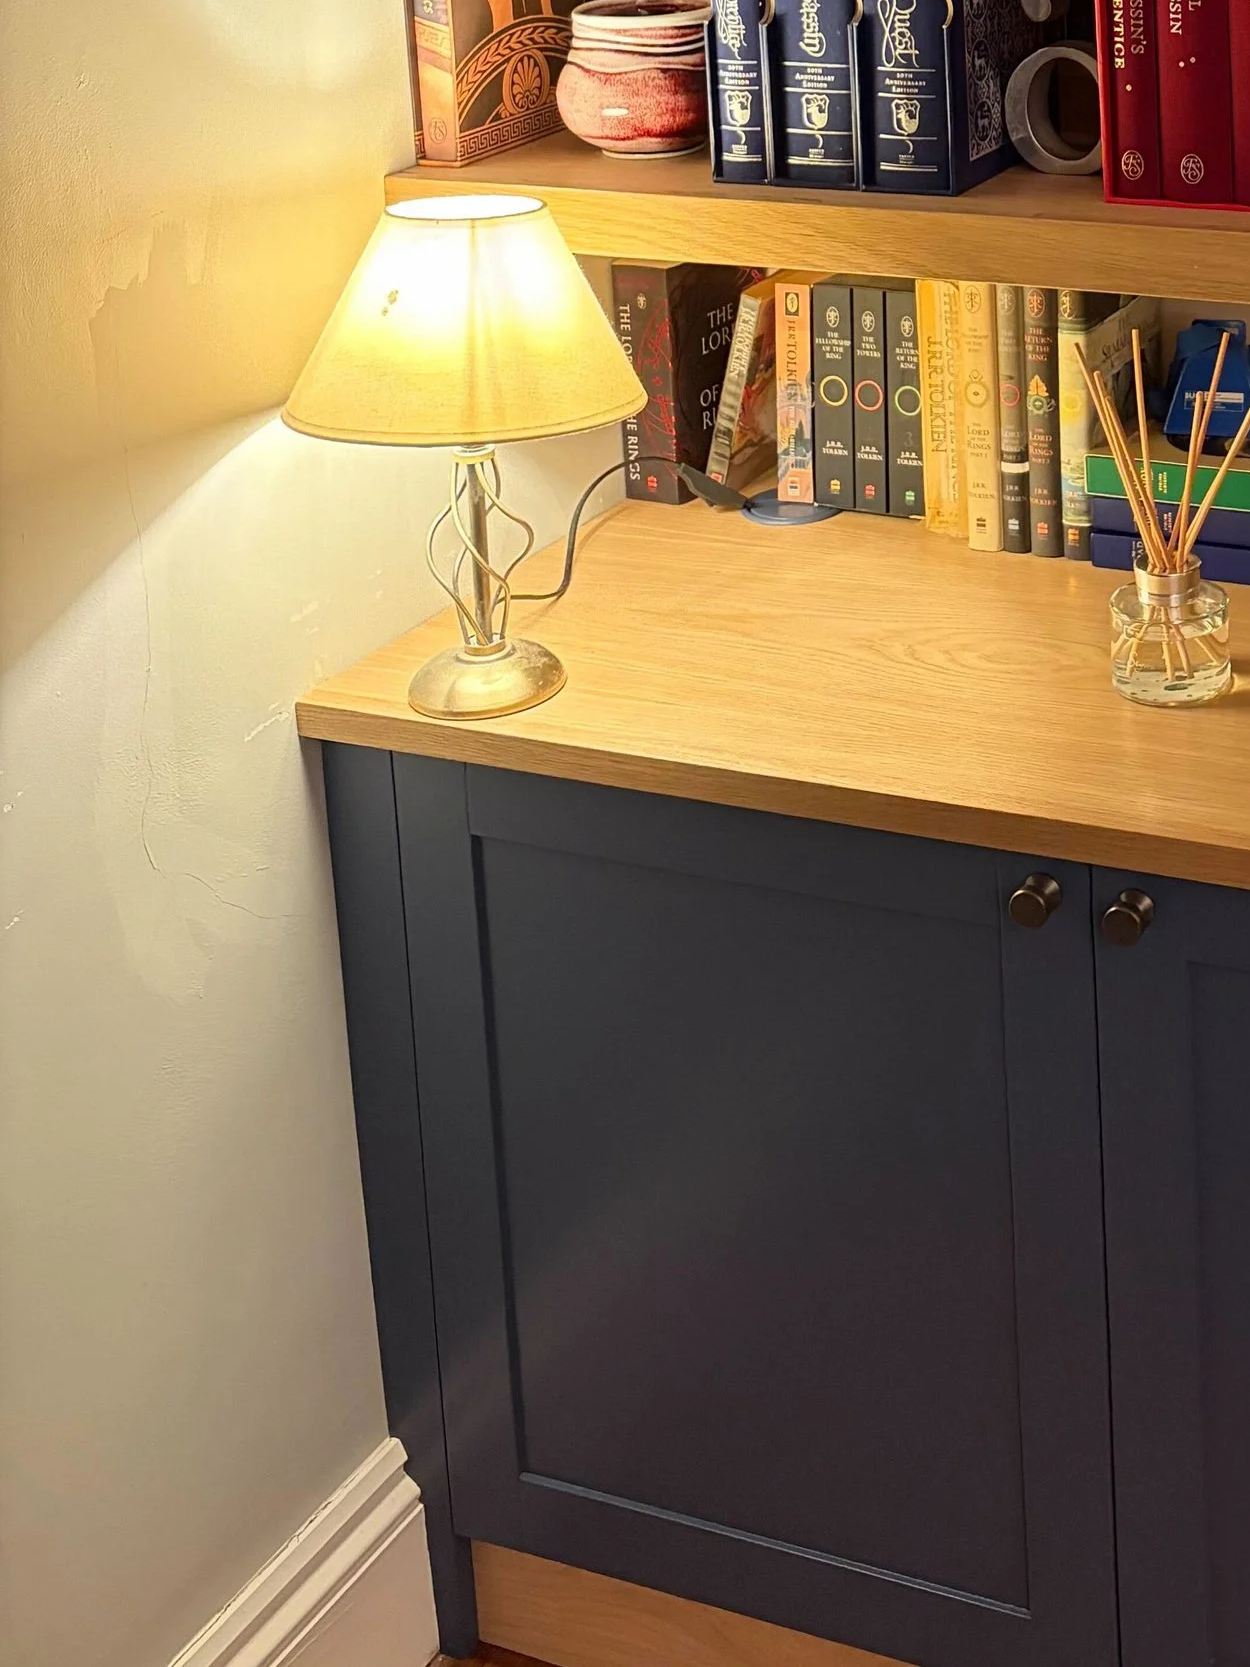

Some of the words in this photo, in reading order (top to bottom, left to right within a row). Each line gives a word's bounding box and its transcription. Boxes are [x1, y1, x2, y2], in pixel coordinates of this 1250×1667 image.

[707, 303, 734, 328] THE
[628, 436, 640, 480] RINGS
[822, 446, 848, 456] TOLKIEN
